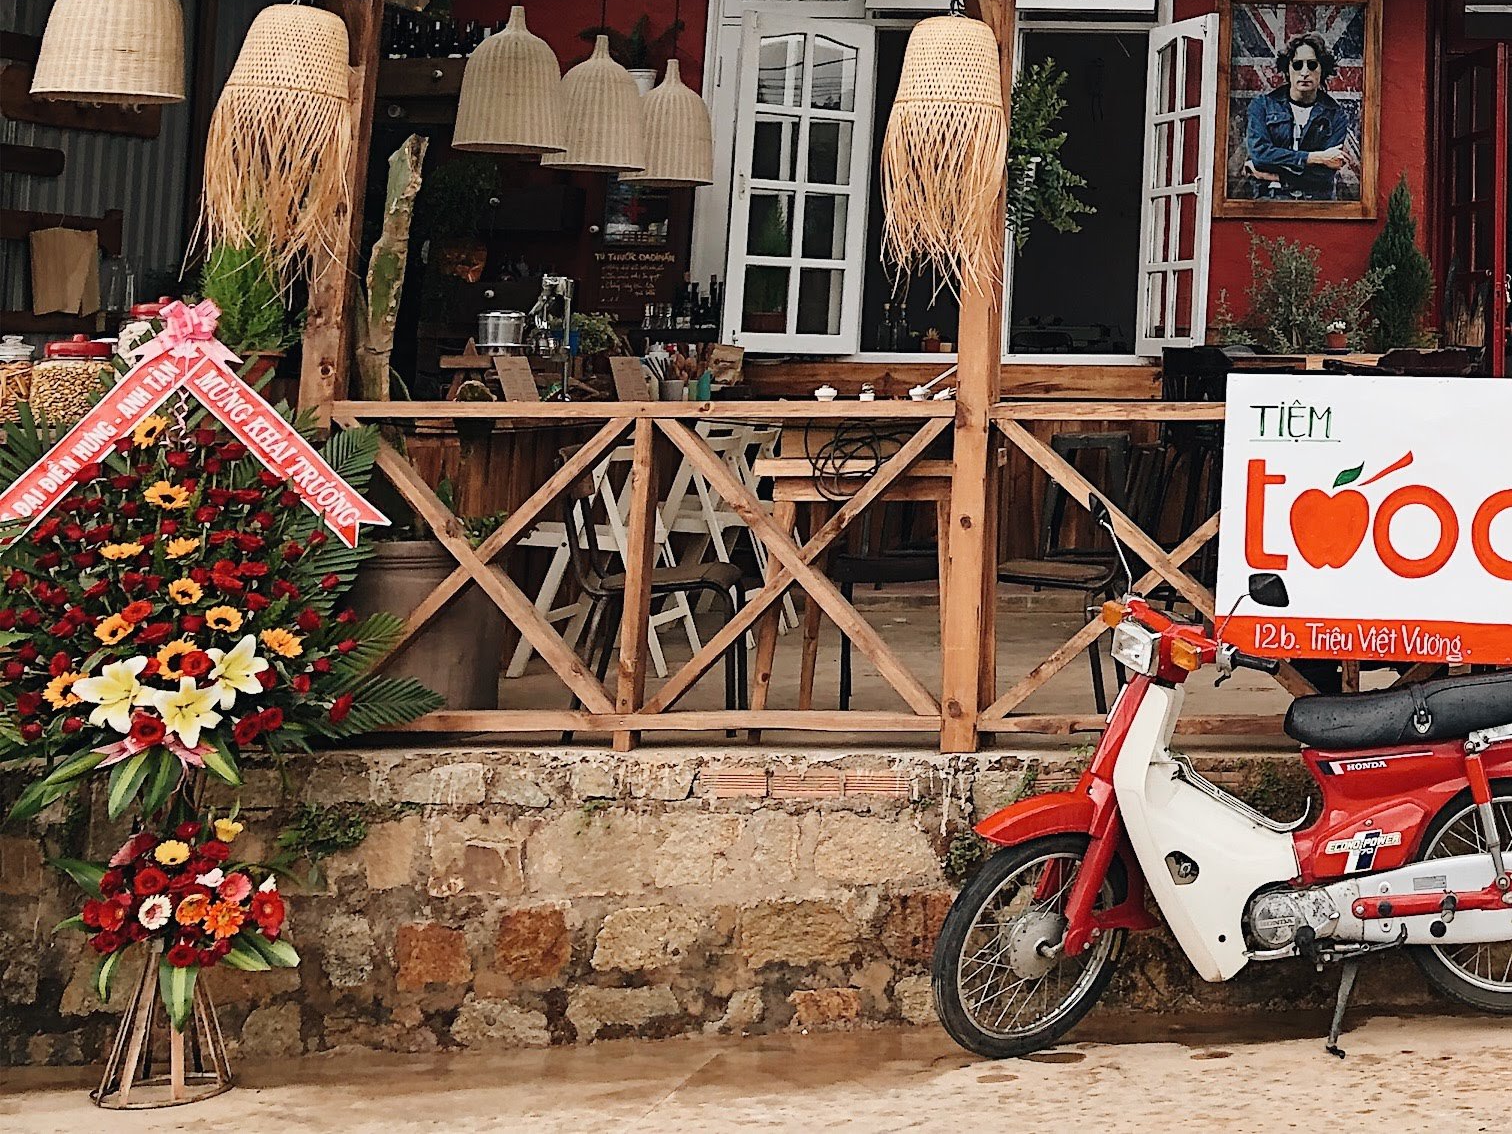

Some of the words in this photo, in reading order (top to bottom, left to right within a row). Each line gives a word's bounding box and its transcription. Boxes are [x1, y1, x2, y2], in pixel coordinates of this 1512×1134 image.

[116, 385, 154, 420] ANH
[241, 415, 298, 465] KHAI
[285, 455, 363, 527] TRƯƠNG
[1305, 622, 1353, 655] Triệu
[1357, 623, 1397, 658] Việt
[1346, 760, 1388, 772] HONDA
